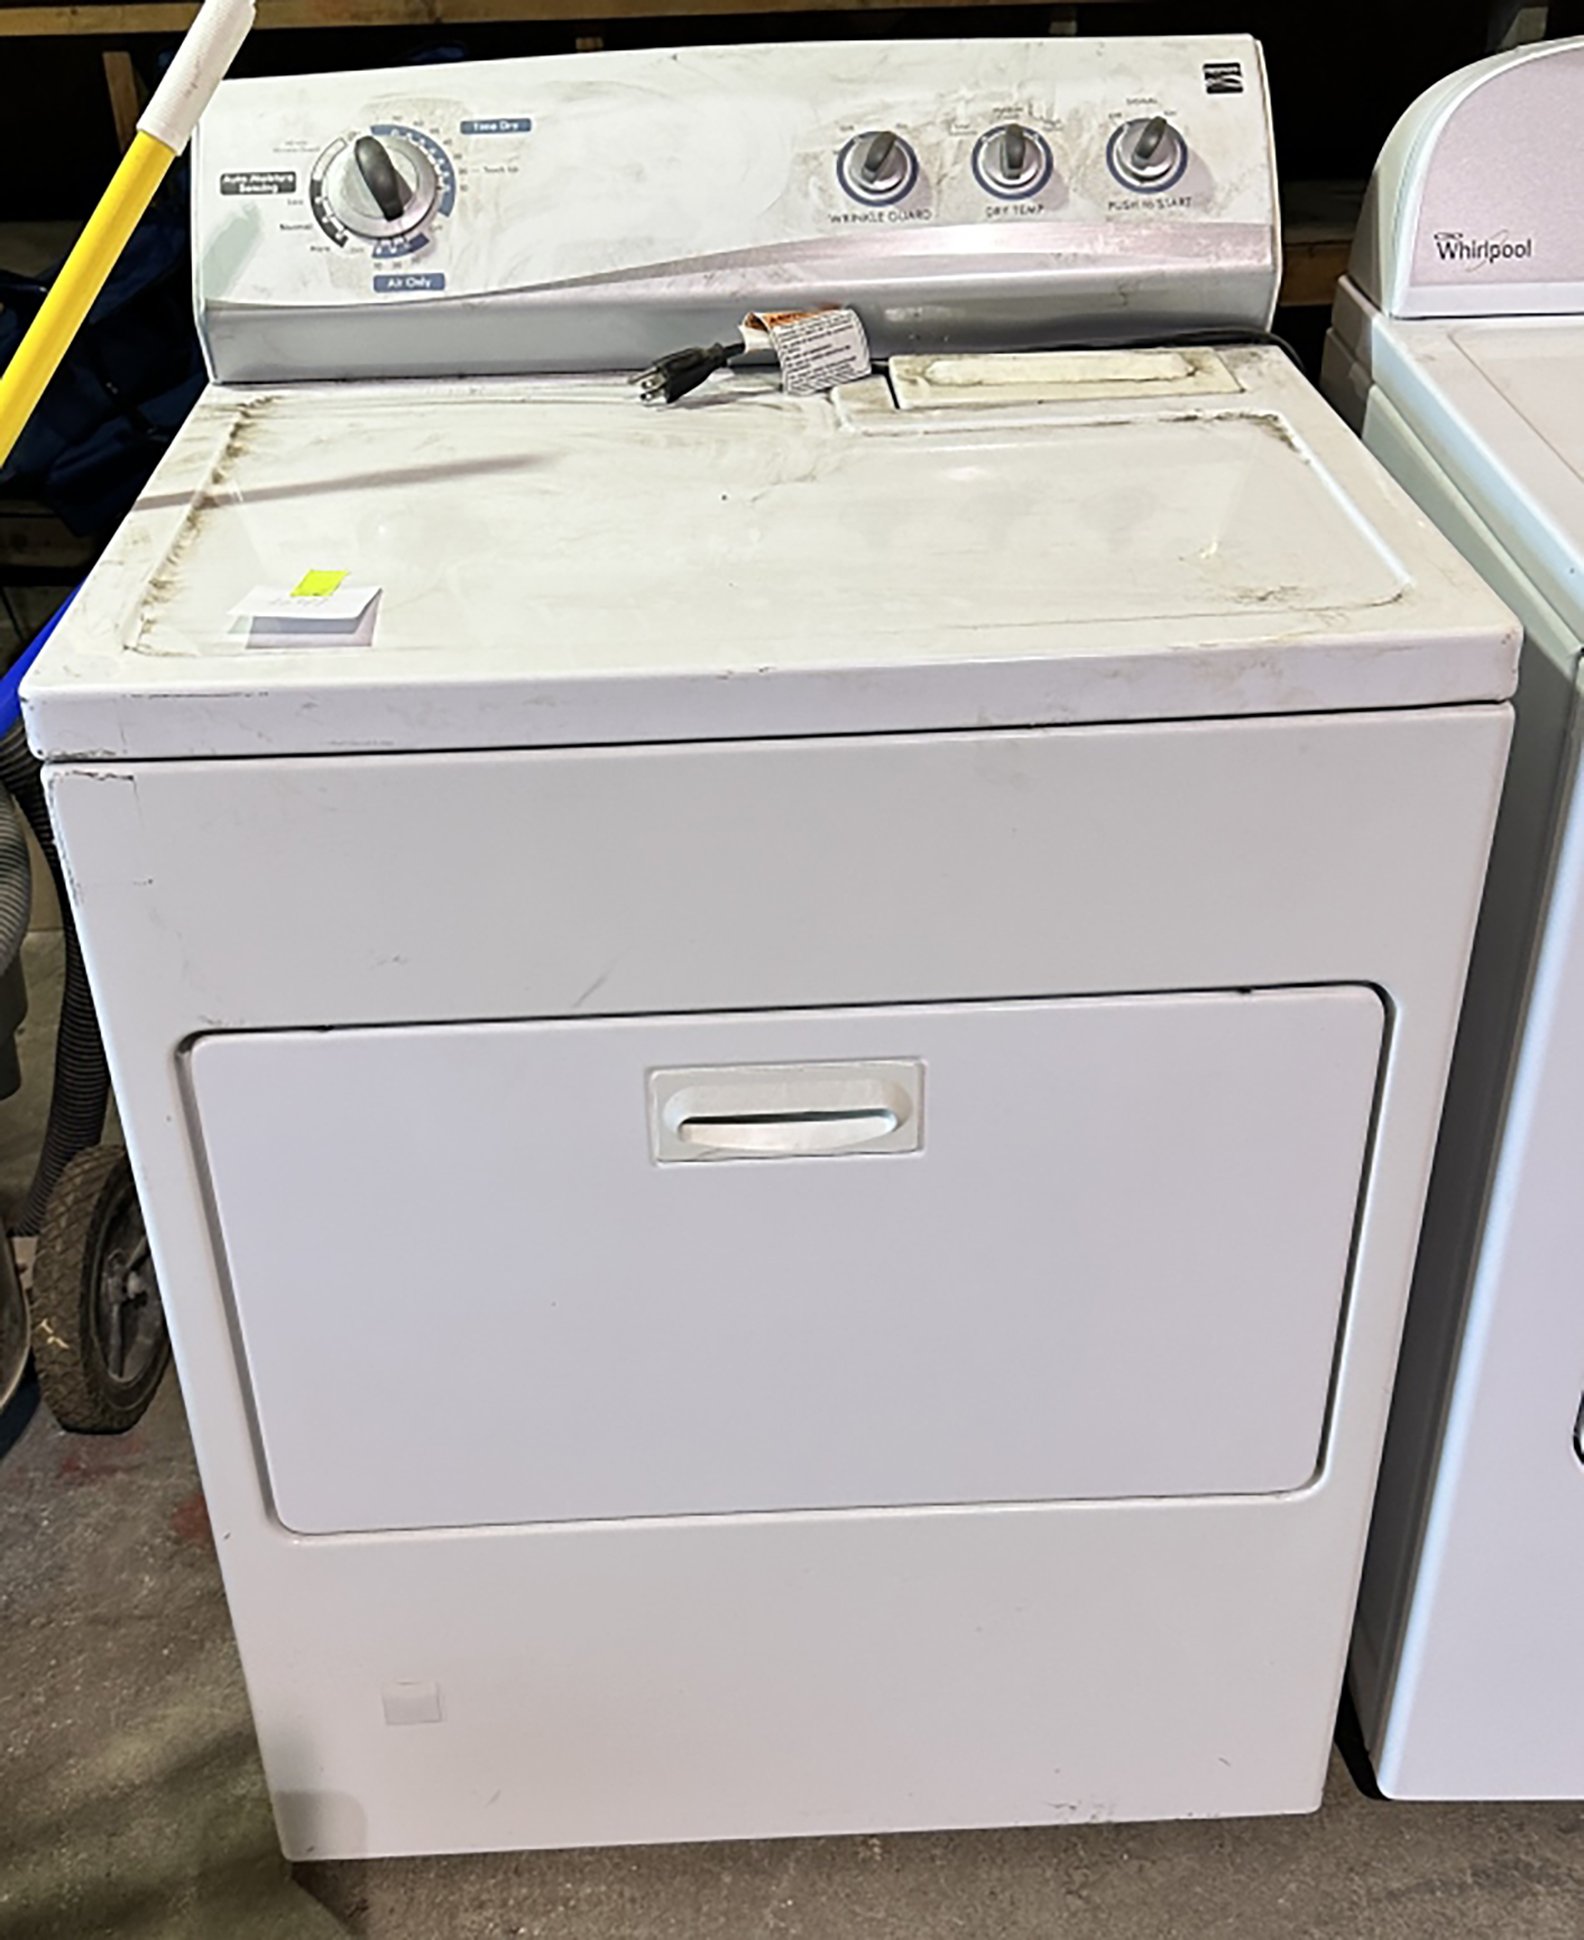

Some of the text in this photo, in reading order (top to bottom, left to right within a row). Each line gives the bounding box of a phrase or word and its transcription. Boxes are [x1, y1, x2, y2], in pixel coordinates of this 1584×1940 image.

[499, 119, 520, 131] Dry
[828, 211, 885, 223] WRINKLE
[1436, 238, 1532, 264] Whirlpool
[387, 276, 432, 290] Air Only
